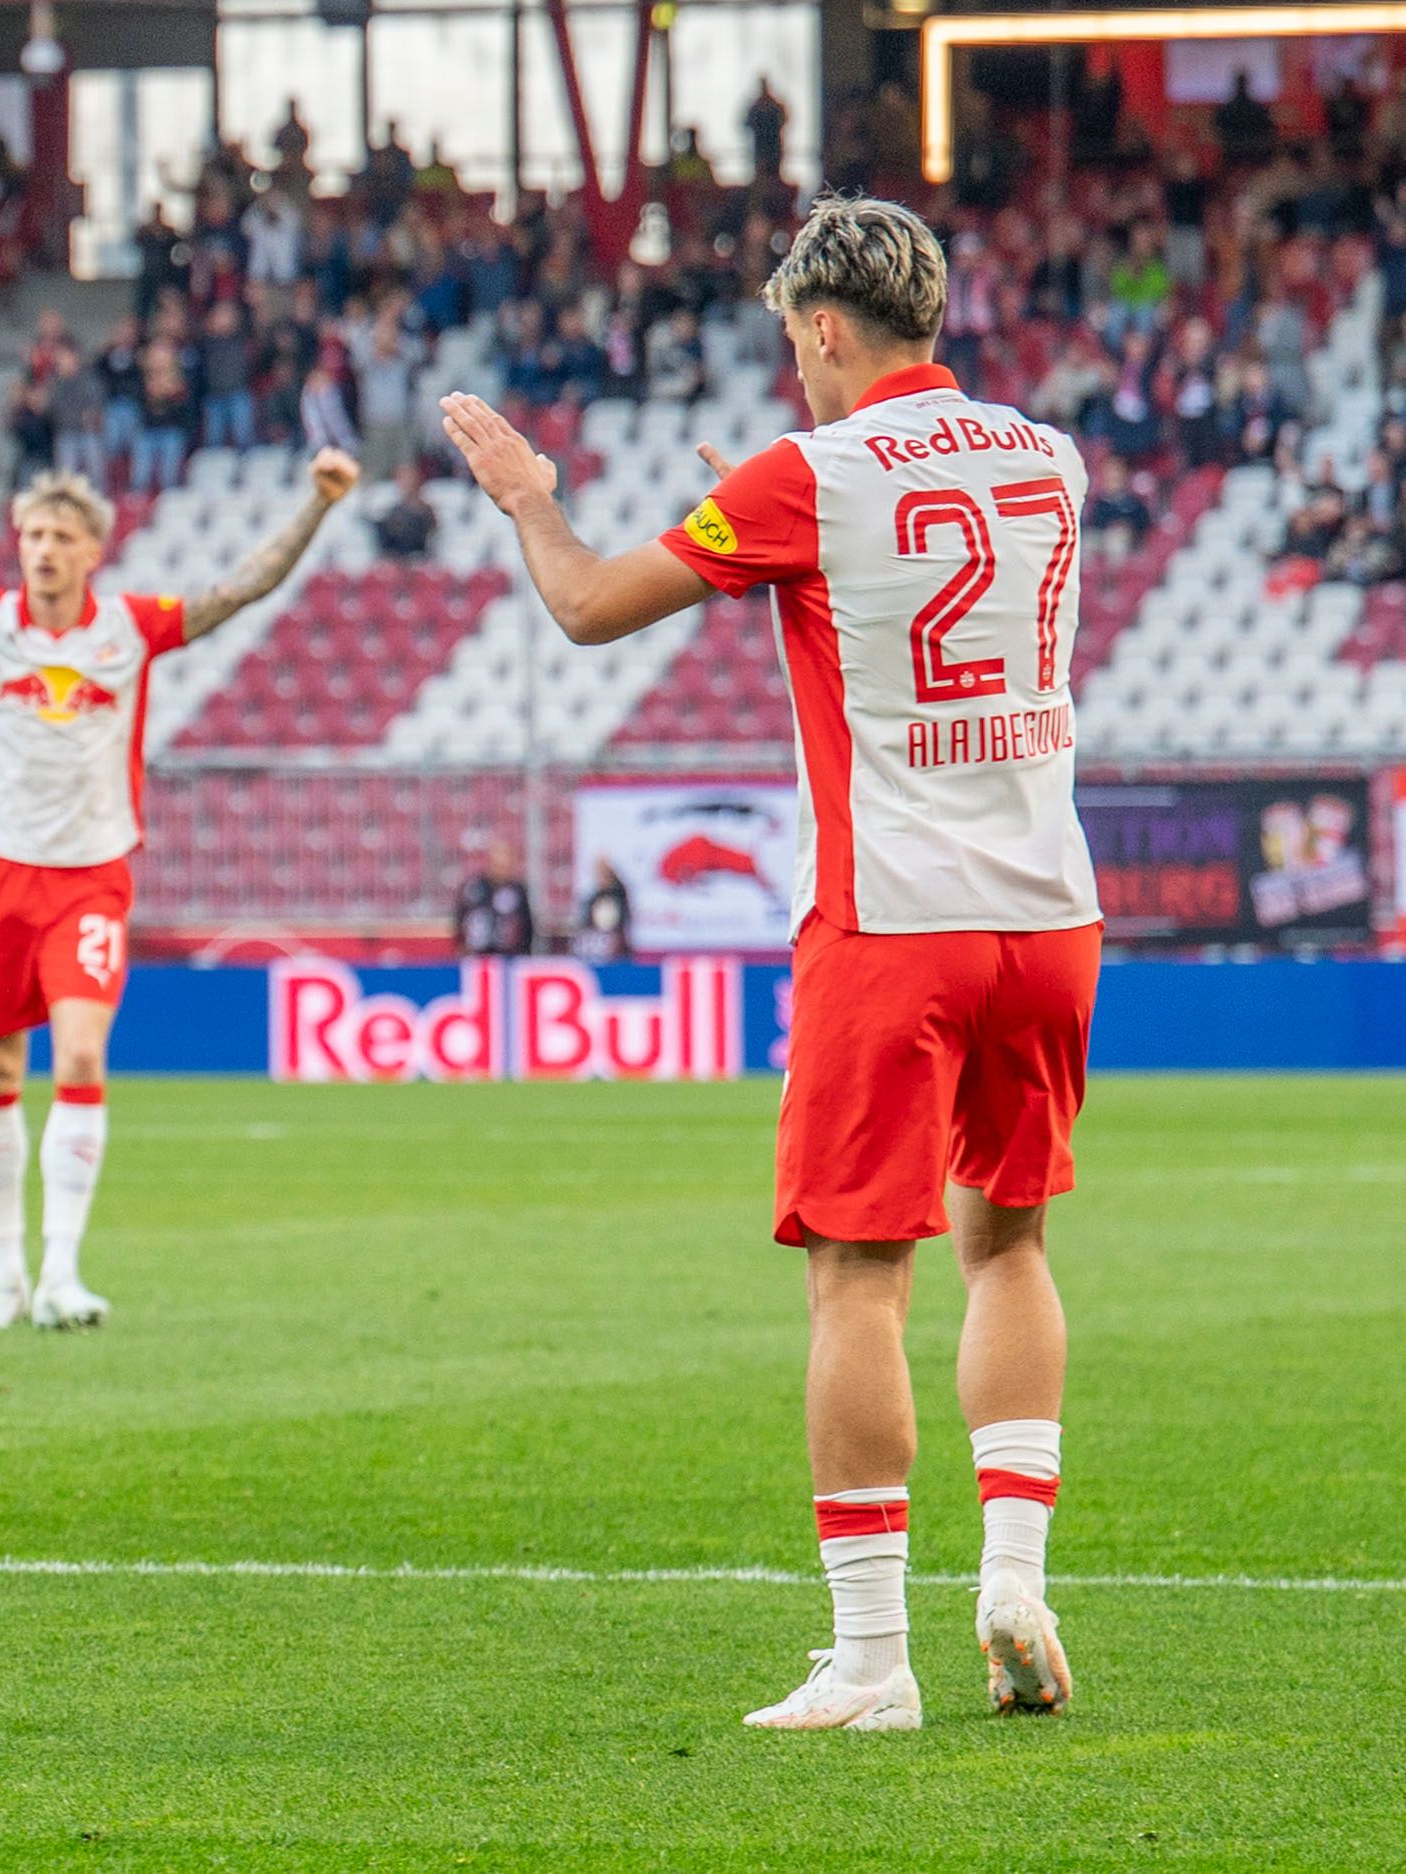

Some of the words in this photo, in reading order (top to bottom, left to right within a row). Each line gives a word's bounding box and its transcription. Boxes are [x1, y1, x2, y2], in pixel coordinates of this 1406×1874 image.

[865, 417, 960, 471] Red
[955, 418, 1055, 458] Bulls
[895, 477, 1078, 704] 27
[77, 914, 124, 973] 21
[281, 954, 496, 1075] Red
[520, 957, 731, 1075] Bull
